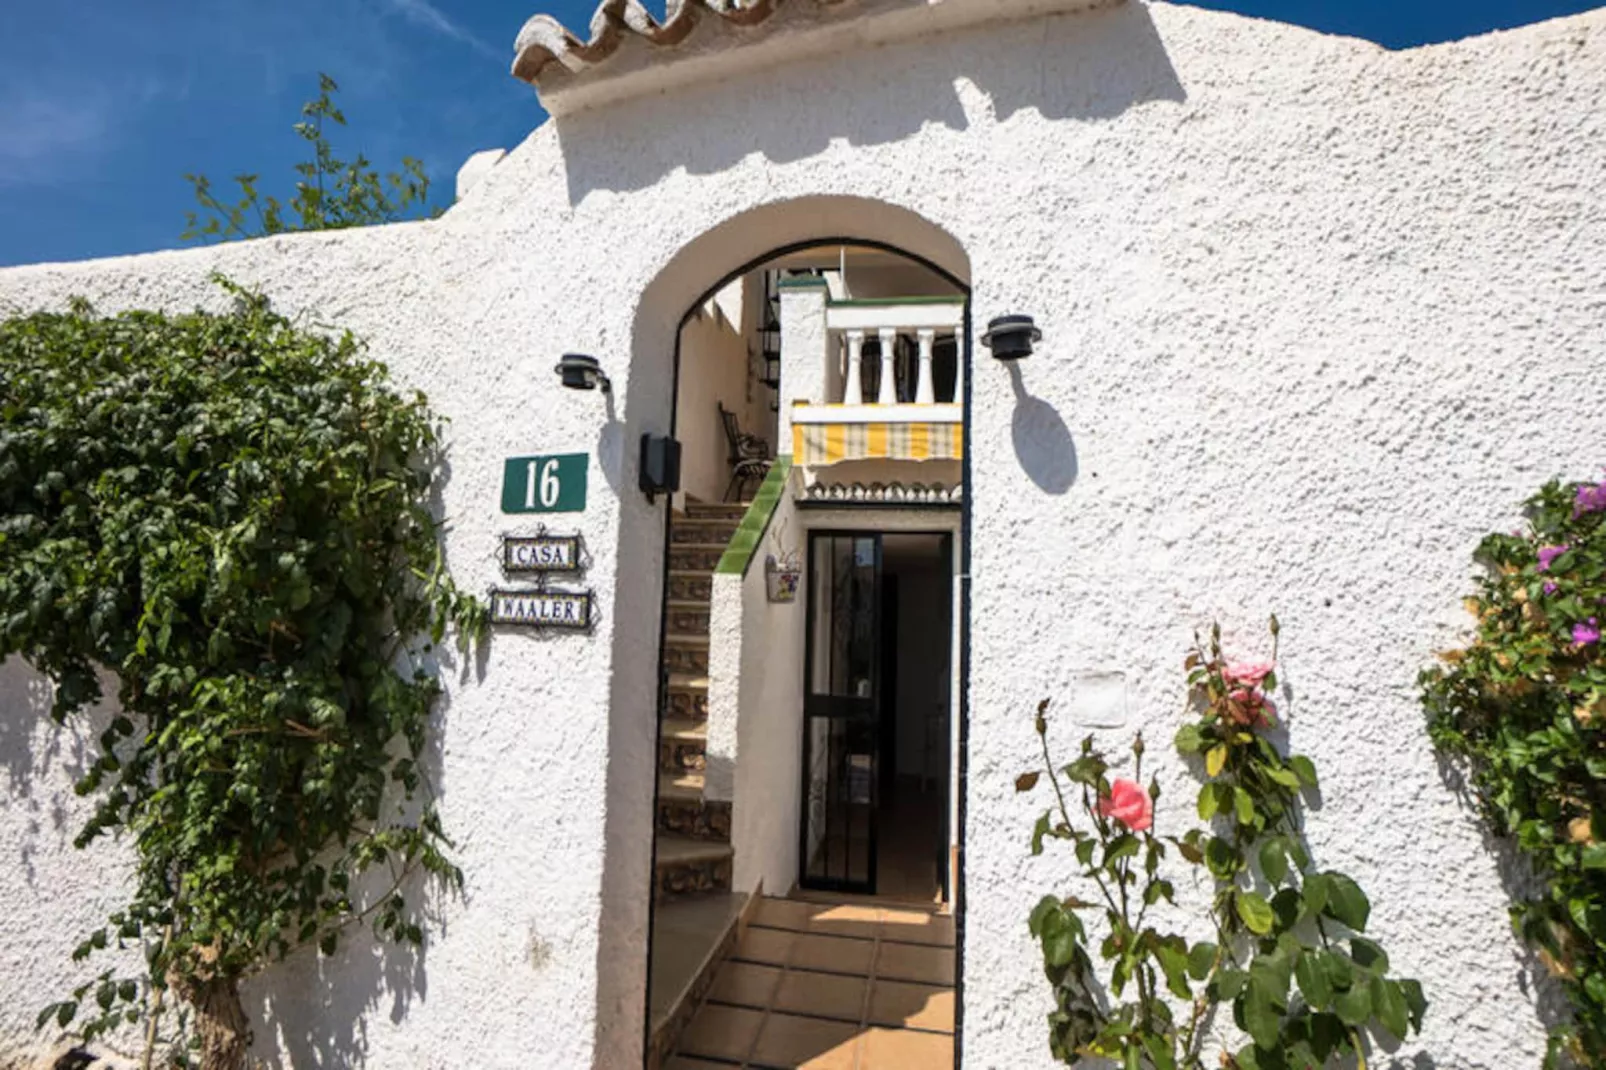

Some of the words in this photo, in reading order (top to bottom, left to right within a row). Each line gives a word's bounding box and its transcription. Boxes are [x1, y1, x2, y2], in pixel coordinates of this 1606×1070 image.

[525, 458, 560, 509] 16
[517, 546, 563, 563] CASA
[503, 599, 574, 619] WAALER
